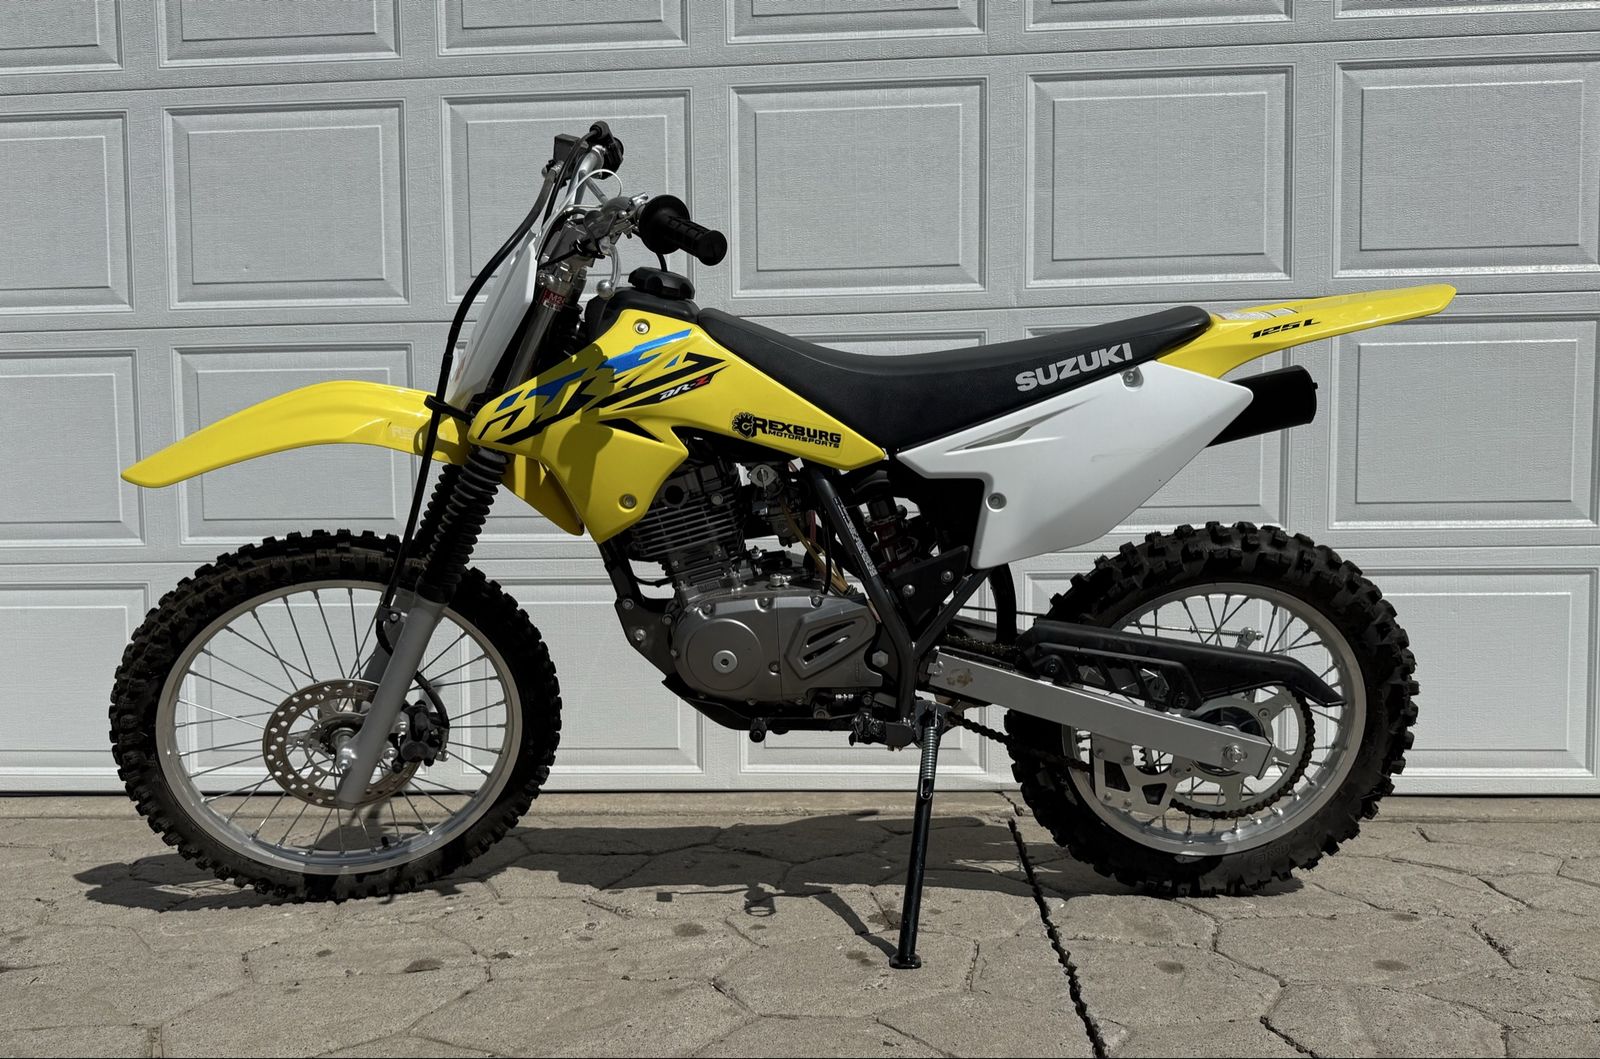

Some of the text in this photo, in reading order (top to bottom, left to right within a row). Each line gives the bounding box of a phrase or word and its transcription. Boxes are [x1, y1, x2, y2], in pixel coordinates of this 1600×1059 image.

[1015, 342, 1133, 392] SUZUKI
[659, 376, 709, 401] DR-Z
[753, 418, 842, 444] REXBURG
[769, 430, 841, 448] MOTORSPORTS
